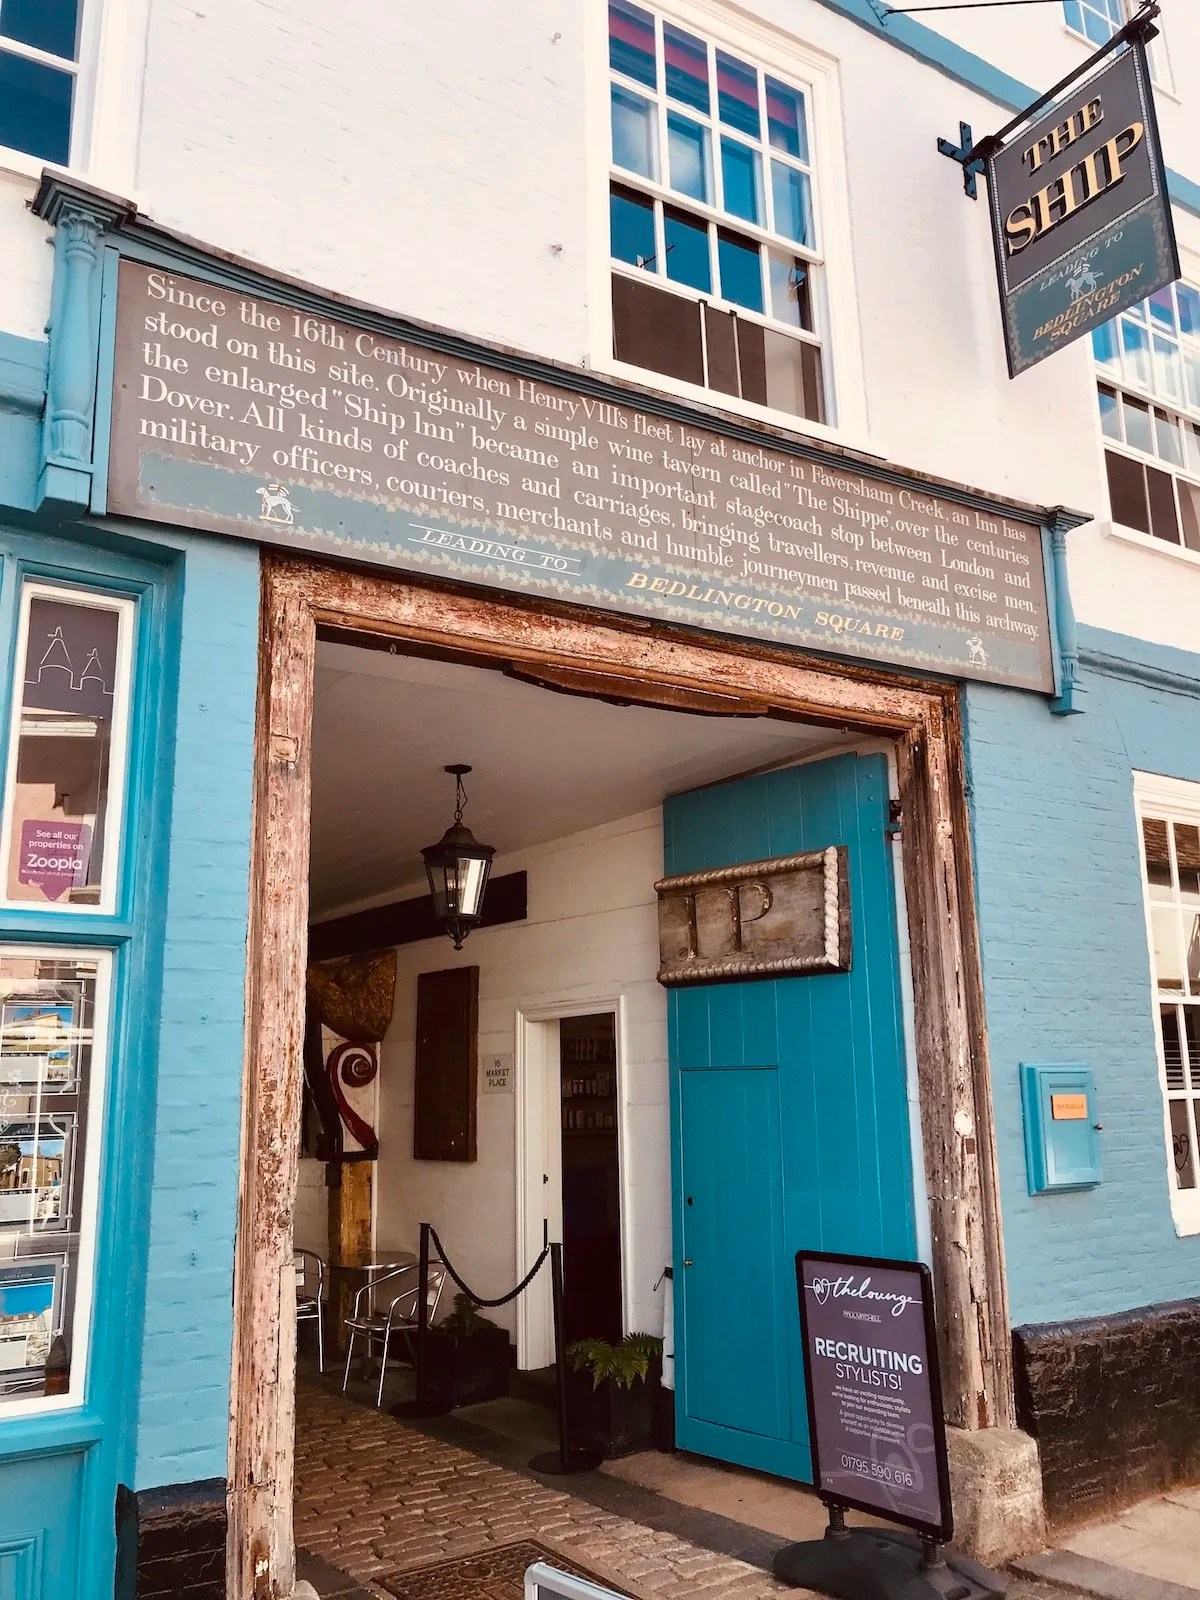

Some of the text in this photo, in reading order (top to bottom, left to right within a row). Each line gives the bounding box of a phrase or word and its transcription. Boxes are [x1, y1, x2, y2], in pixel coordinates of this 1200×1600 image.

[1022, 94, 1105, 177] THE
[1005, 122, 1144, 256] SHIP
[1040, 231, 1123, 292] LEADING TO
[1032, 262, 1144, 341] BEDLINGTON
[1050, 290, 1121, 342] SQUARE
[147, 273, 226, 317] Since
[238, 301, 281, 332] the
[292, 315, 346, 351] 16th
[355, 334, 448, 384] Century
[456, 367, 511, 397] when
[633, 413, 674, 443] fleet
[680, 426, 706, 457] lay
[711, 439, 727, 458] at
[732, 448, 785, 474] anchor
[789, 460, 804, 480] in
[811, 464, 895, 505] Faversham
[899, 490, 949, 522] Creek,
[952, 510, 970, 527] an
[975, 511, 998, 535] Inn
[1002, 520, 1027, 543] has
[142, 342, 188, 374] the
[205, 365, 328, 411] enlarged
[471, 426, 559, 469] became
[572, 459, 600, 480] an
[611, 464, 717, 509] important
[726, 497, 823, 537] stagecoach
[831, 525, 864, 550] stop
[870, 531, 932, 564] between
[941, 549, 995, 581] London
[1005, 571, 1031, 590] and
[144, 312, 219, 349] stood
[226, 338, 259, 360] on
[267, 341, 316, 374] this
[328, 361, 380, 391] site.
[386, 374, 507, 431] Originally
[513, 415, 527, 431] a
[534, 417, 599, 451] simple
[606, 439, 654, 465] wine
[662, 451, 722, 483] tavern
[729, 472, 782, 500] called
[895, 518, 929, 538] over
[934, 524, 959, 547] the
[966, 538, 1030, 566] centuries
[137, 374, 1037, 615] Dover. All kinds of coaches and carriages, bringing travellers, revenue and excise men,
[138, 417, 1040, 642] military officers, couriers, merchants and humble journeymen passed beneath this archway.
[421, 530, 568, 571] LEADING TO
[625, 572, 905, 641] BEDLINGTON SQUARE
[27, 853, 82, 871] Zoopla
[28, 840, 71, 849] properties
[36, 829, 52, 838] See
[52, 831, 62, 839] all
[486, 1068, 510, 1077] MARKET
[488, 1078, 507, 1087] PLACE
[814, 1336, 923, 1375] RECRUITING
[835, 1362, 903, 1391] STYLISTS!
[841, 1454, 913, 1486] 01795 590 616
